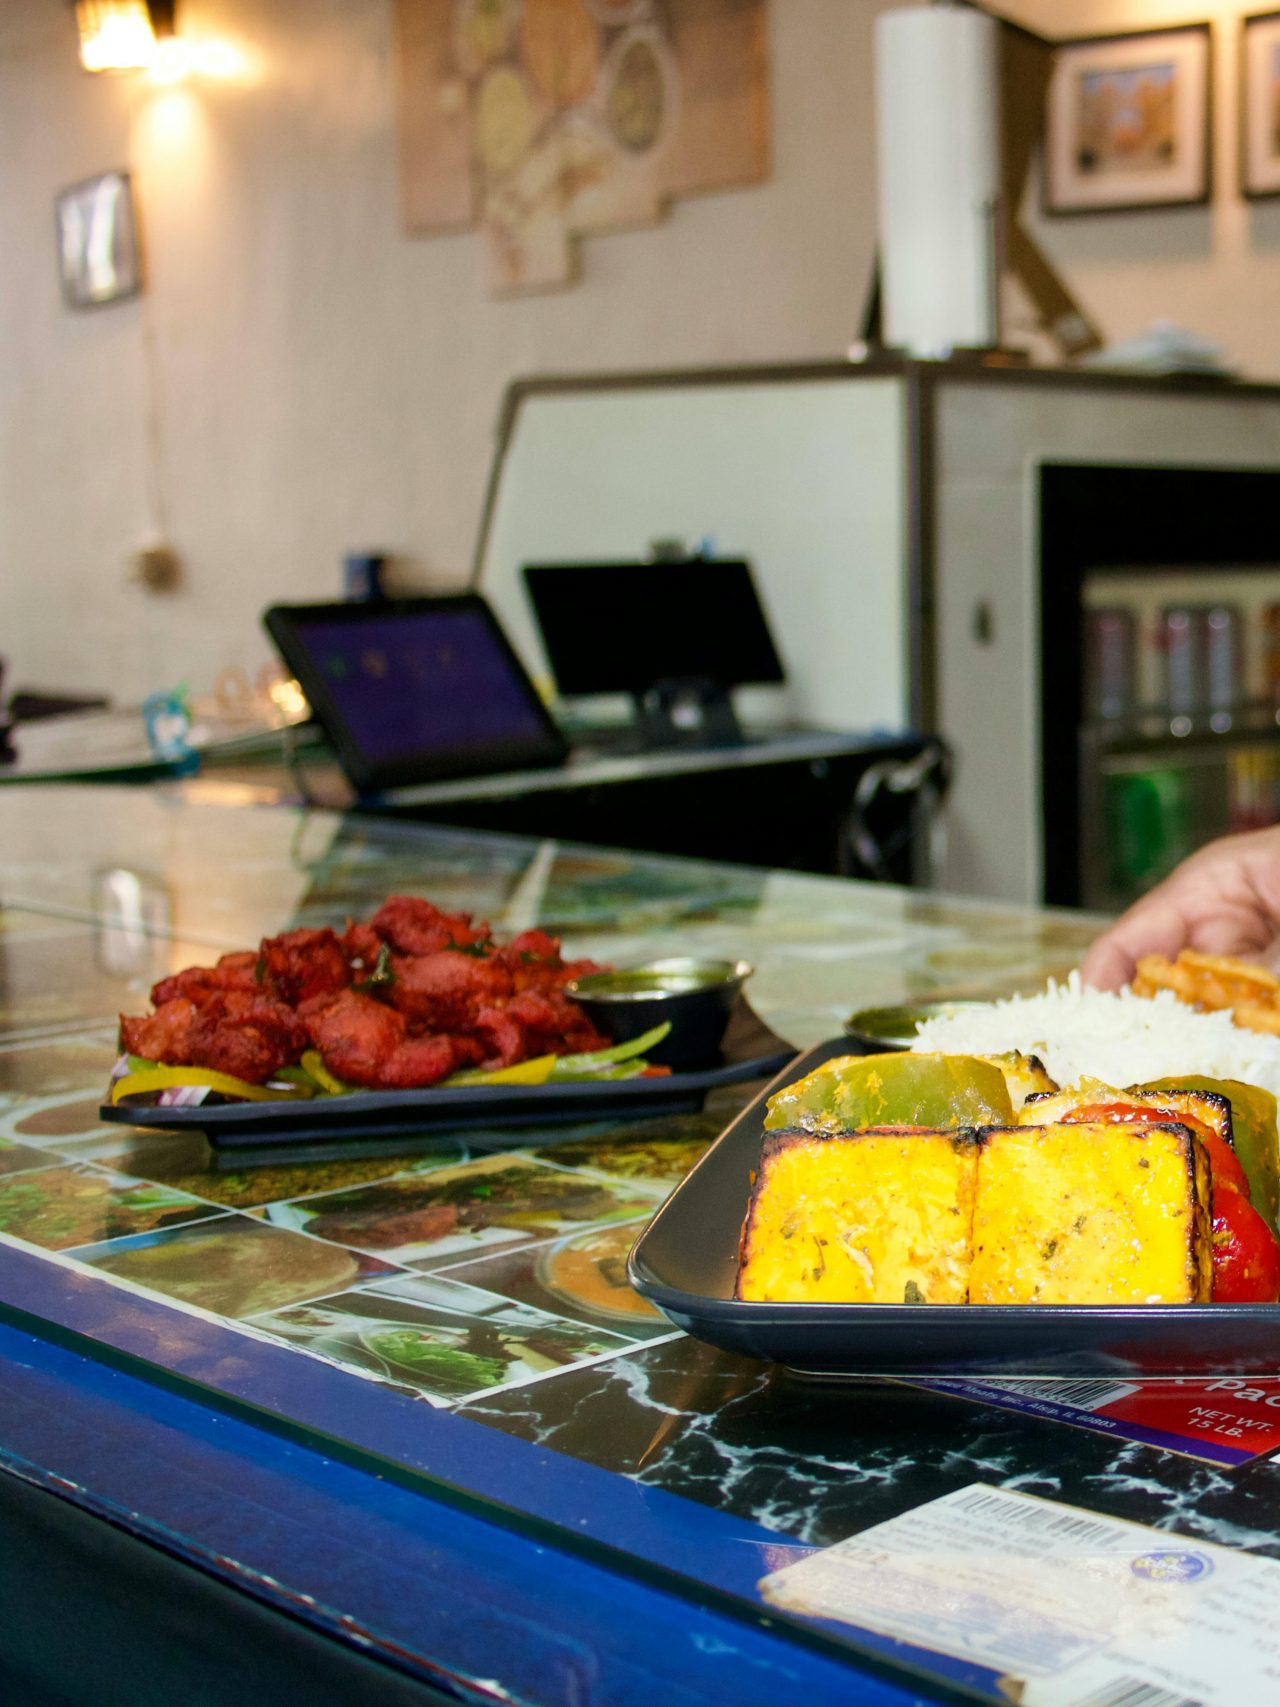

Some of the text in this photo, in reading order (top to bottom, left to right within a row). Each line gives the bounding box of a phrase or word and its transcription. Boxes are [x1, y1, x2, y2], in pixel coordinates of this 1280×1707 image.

[1187, 1417, 1243, 1438] 15 LB.
[1188, 1406, 1275, 1433] NET WT.
